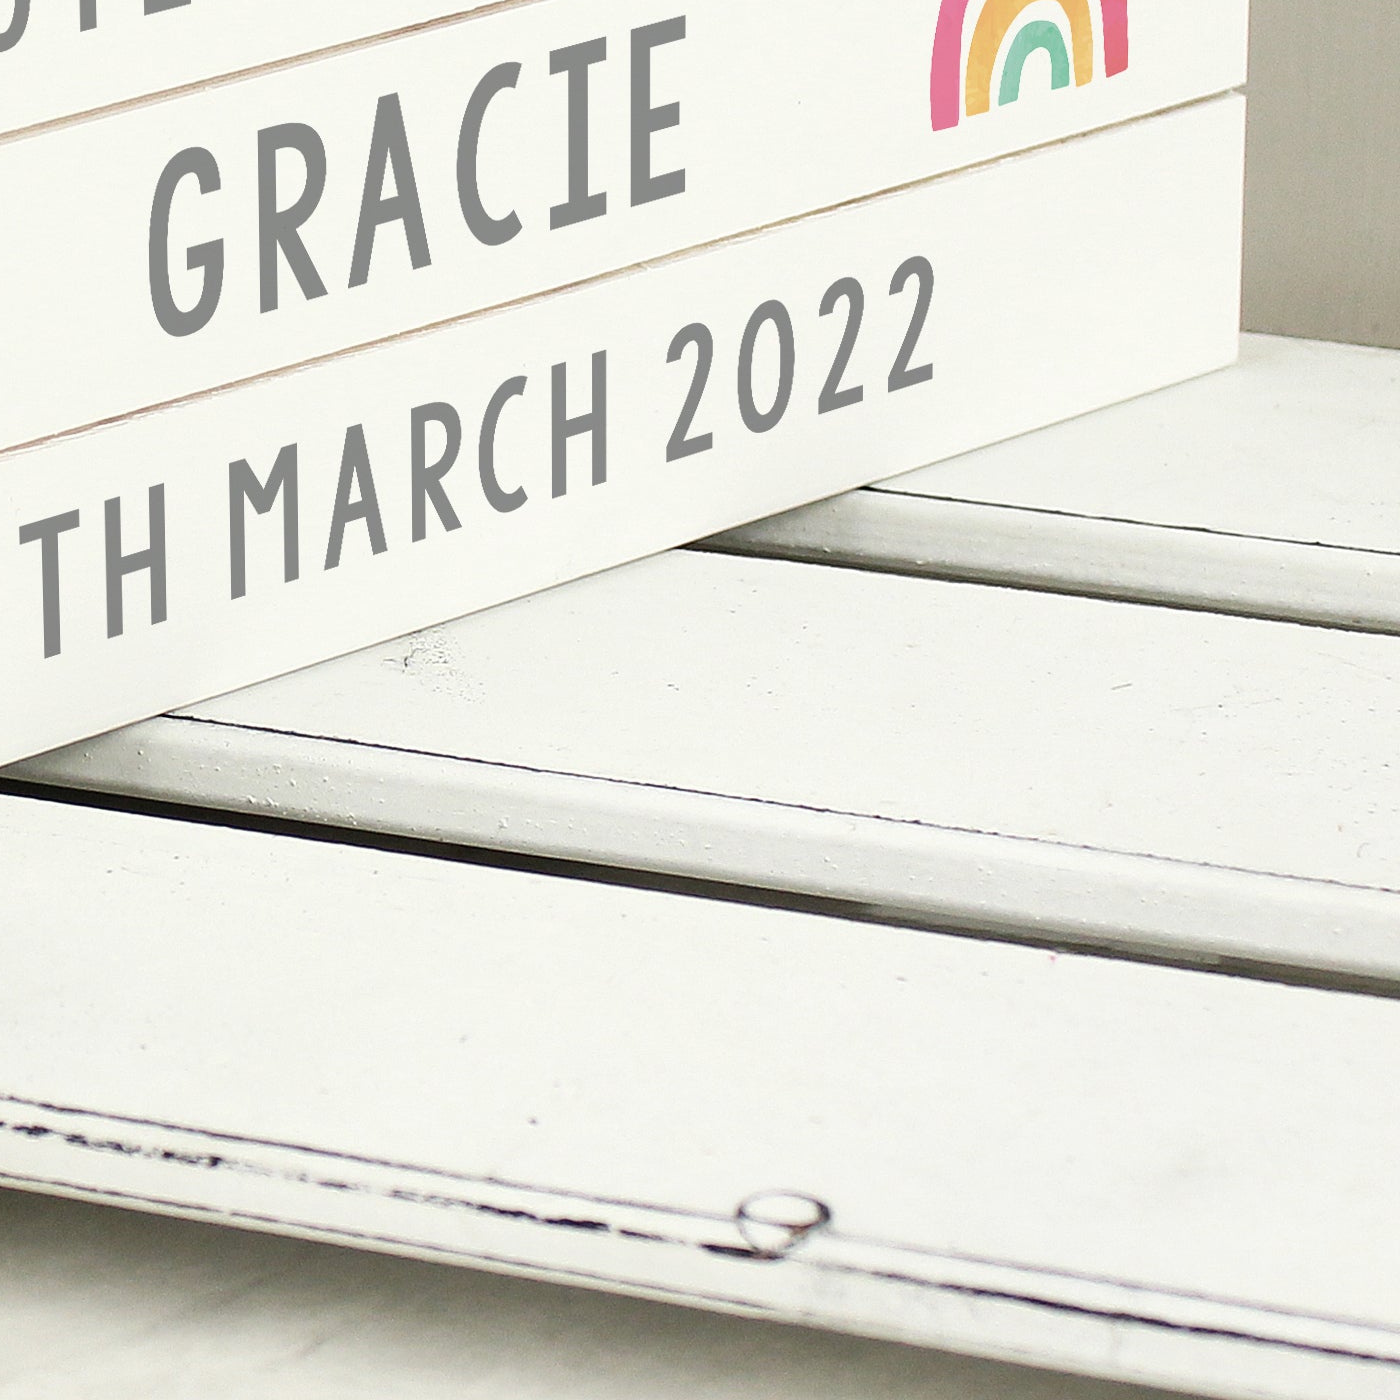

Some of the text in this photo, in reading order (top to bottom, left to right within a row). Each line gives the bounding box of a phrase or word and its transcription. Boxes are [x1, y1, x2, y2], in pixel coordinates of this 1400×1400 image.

[149, 15, 686, 338] GRACIE
[229, 350, 607, 600] MARCH
[666, 256, 935, 463] 2022
